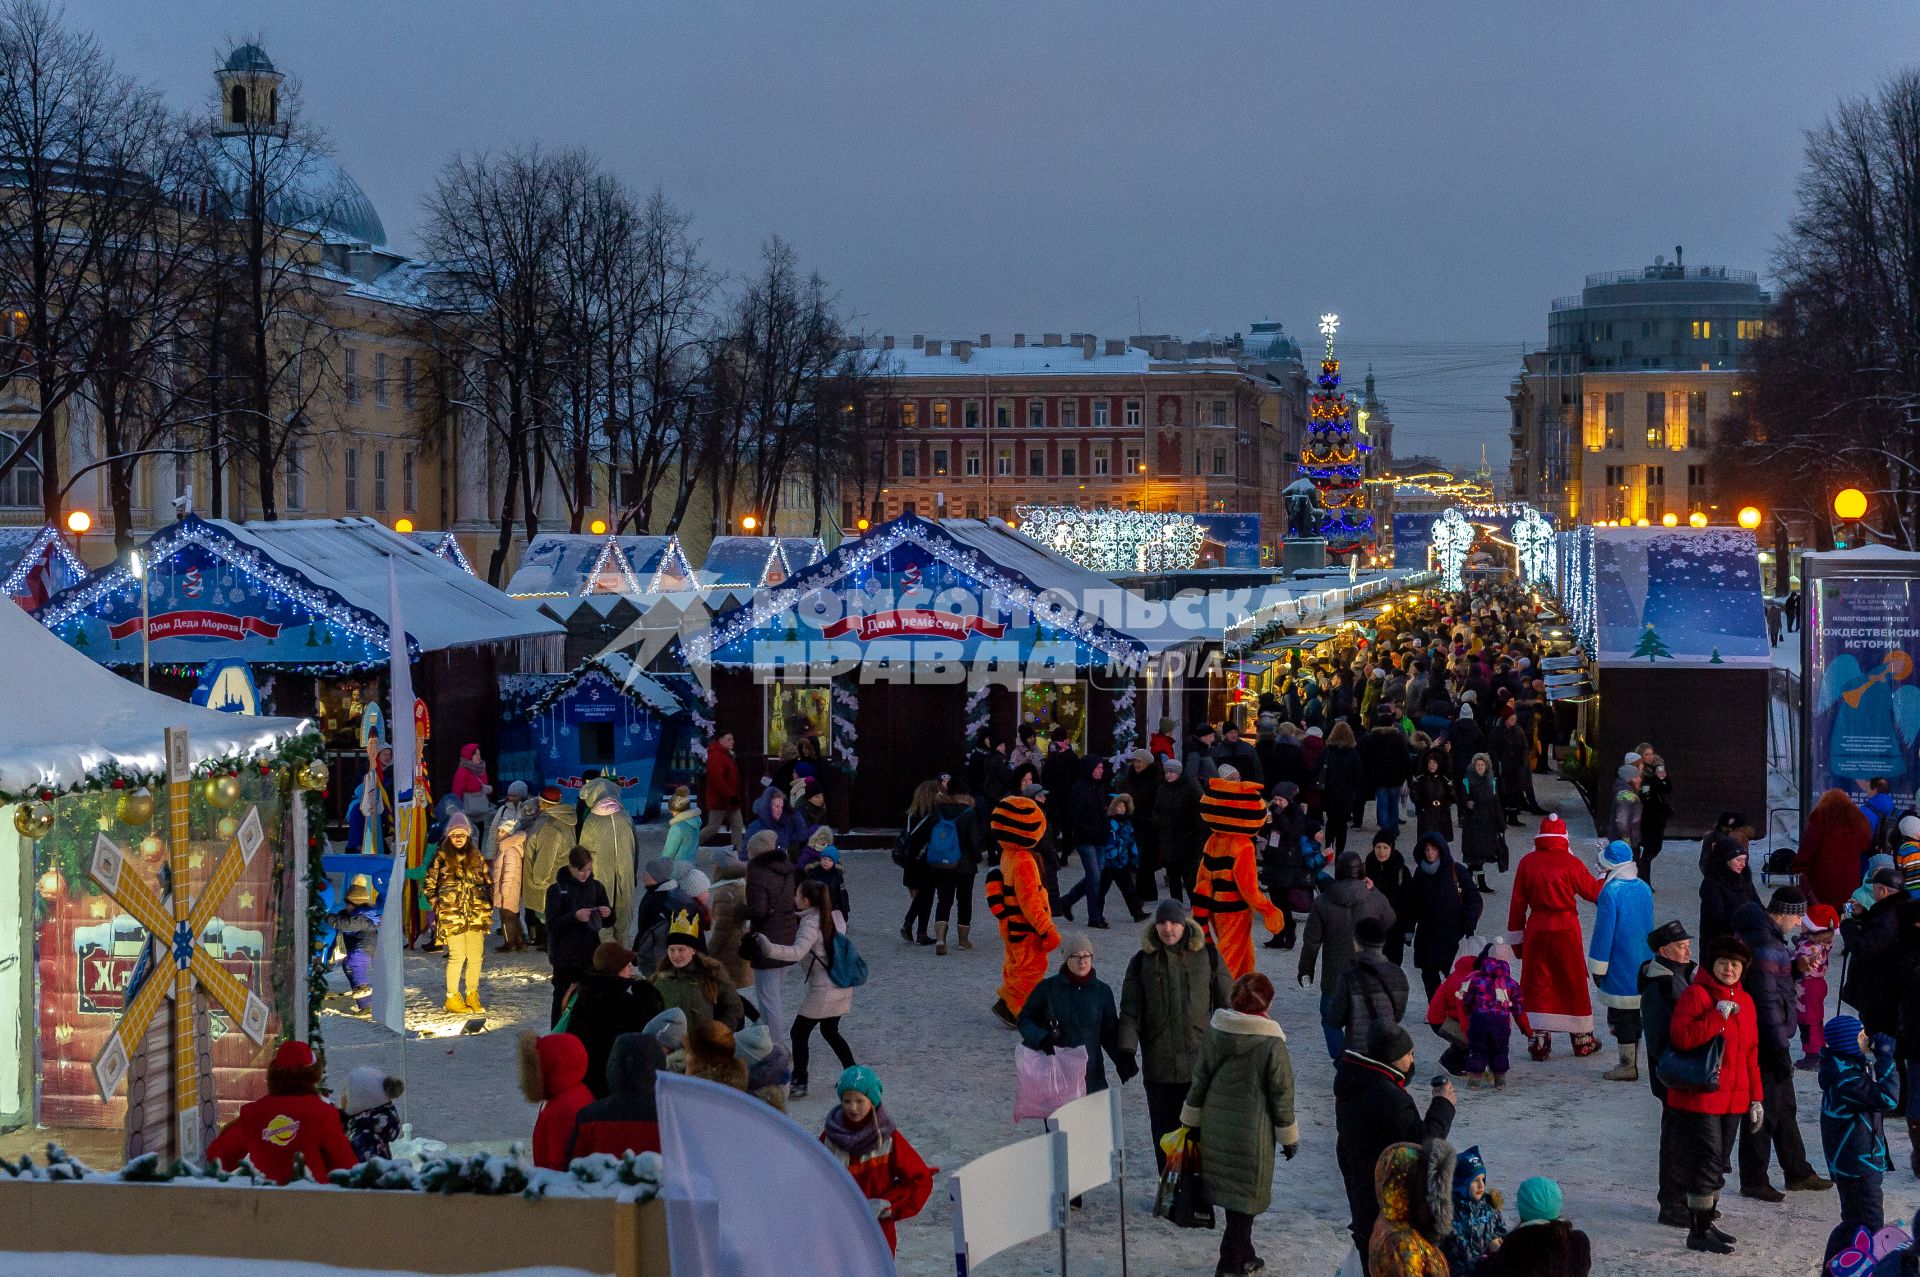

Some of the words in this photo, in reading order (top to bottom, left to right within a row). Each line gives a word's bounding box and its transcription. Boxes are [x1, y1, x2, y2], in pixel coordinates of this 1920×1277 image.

[150, 622, 171, 633] Дом
[173, 619, 198, 629] Деда
[202, 618, 239, 632] Мороза
[868, 619, 897, 634] Дом
[901, 616, 959, 631] ремёсел
[1844, 640, 1901, 649] ИСТОРИИ
